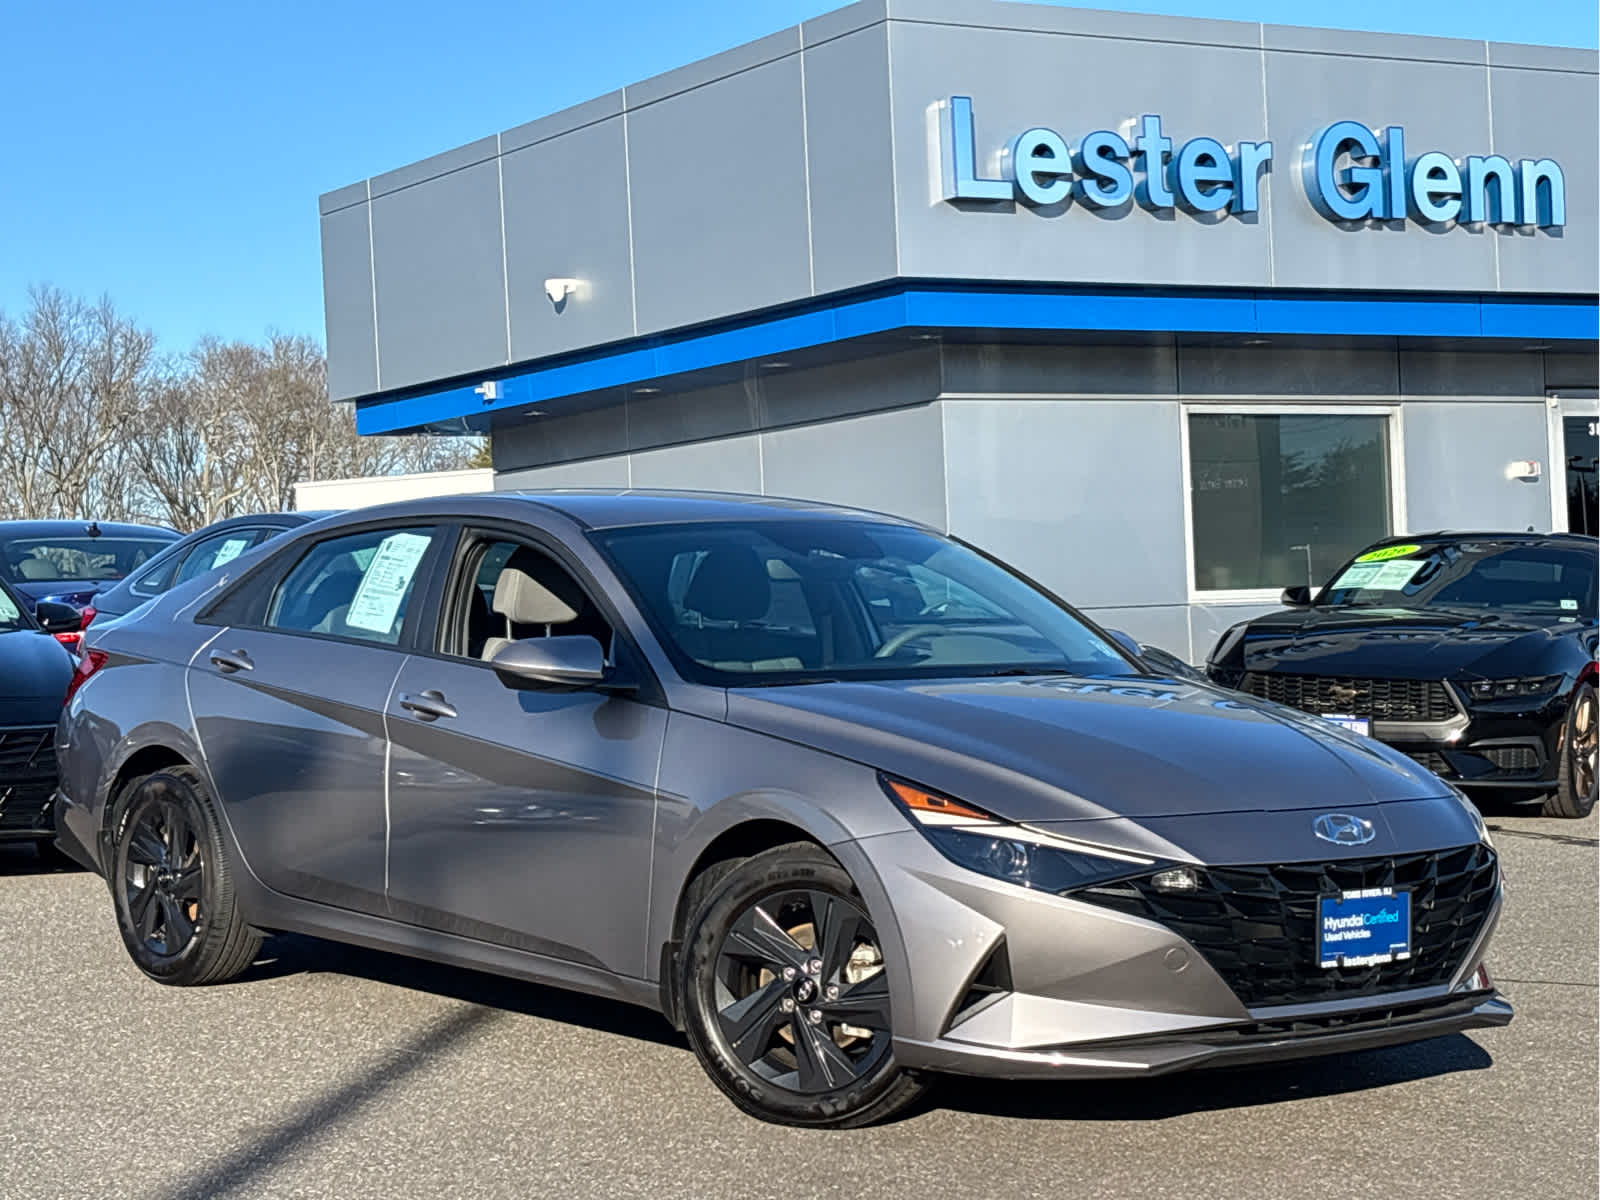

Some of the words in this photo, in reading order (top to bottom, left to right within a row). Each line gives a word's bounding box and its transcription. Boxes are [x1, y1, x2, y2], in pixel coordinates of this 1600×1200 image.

[948, 96, 1272, 213] Lester
[1309, 120, 1566, 226] Glenn
[1324, 932, 1343, 942] Used
[1343, 929, 1371, 940] Vehicles
